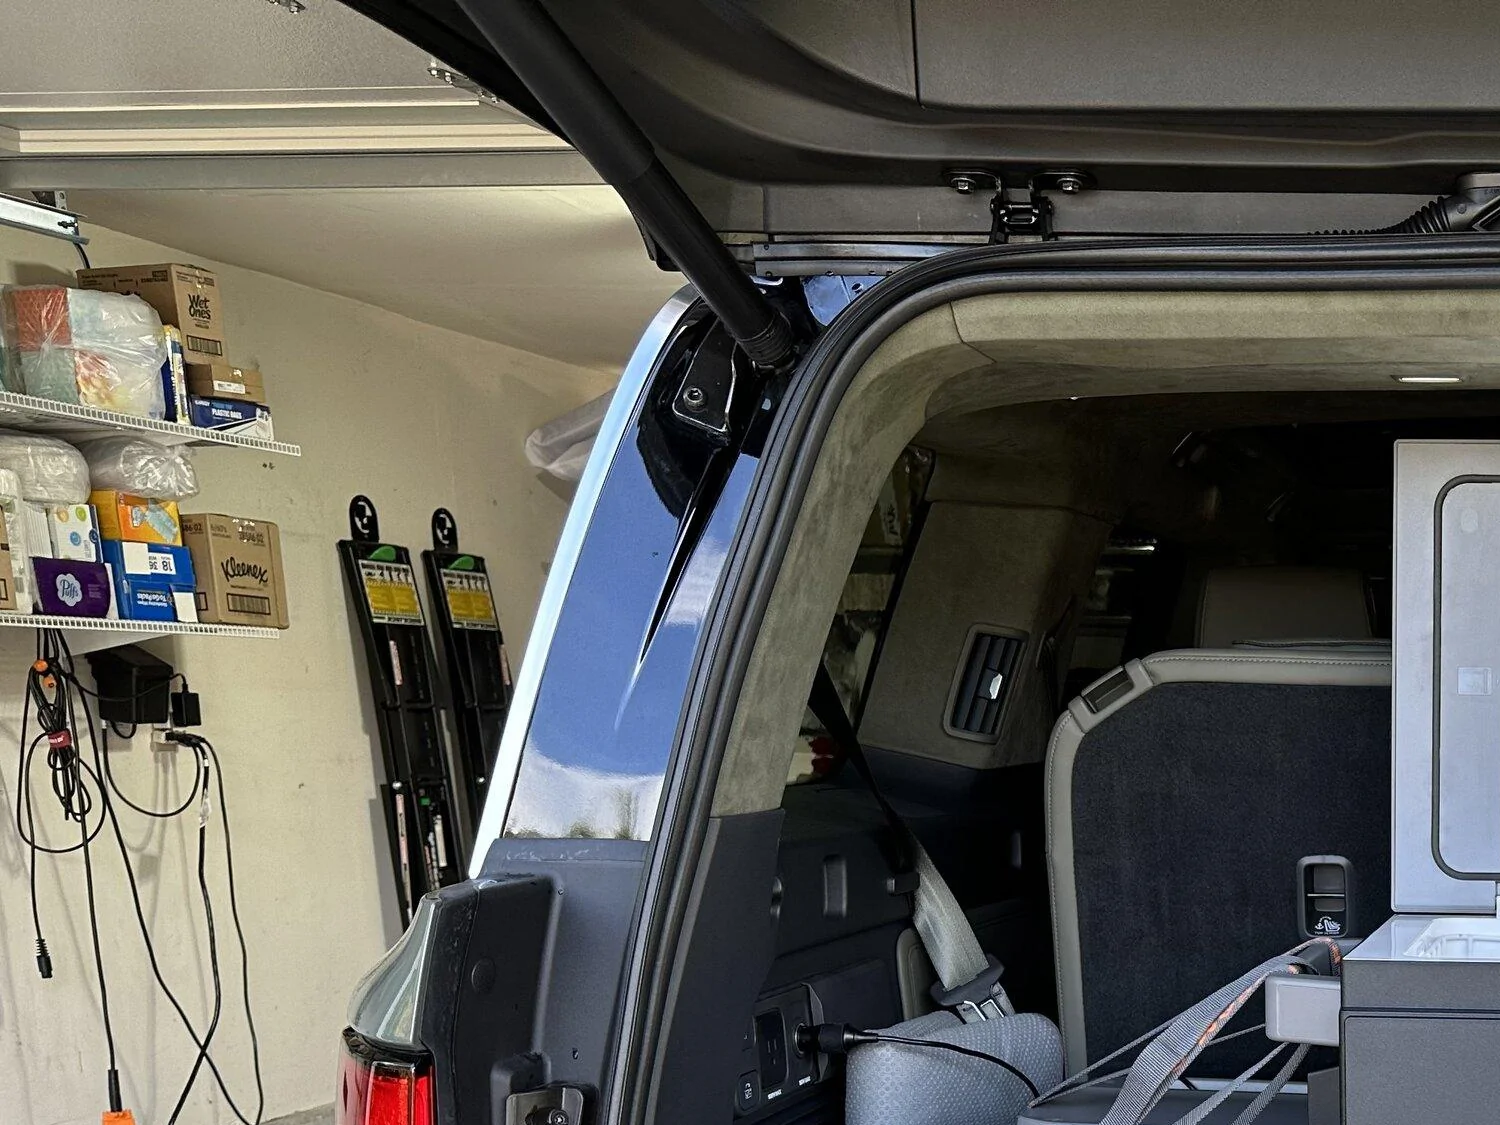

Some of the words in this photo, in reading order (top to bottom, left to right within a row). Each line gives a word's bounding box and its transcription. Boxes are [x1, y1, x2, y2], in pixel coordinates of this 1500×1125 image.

[188, 293, 210, 310] Wet
[188, 304, 212, 320] Ones
[162, 560, 173, 572] 18
[220, 556, 269, 585] Kleenex
[60, 579, 79, 599] Puffs
